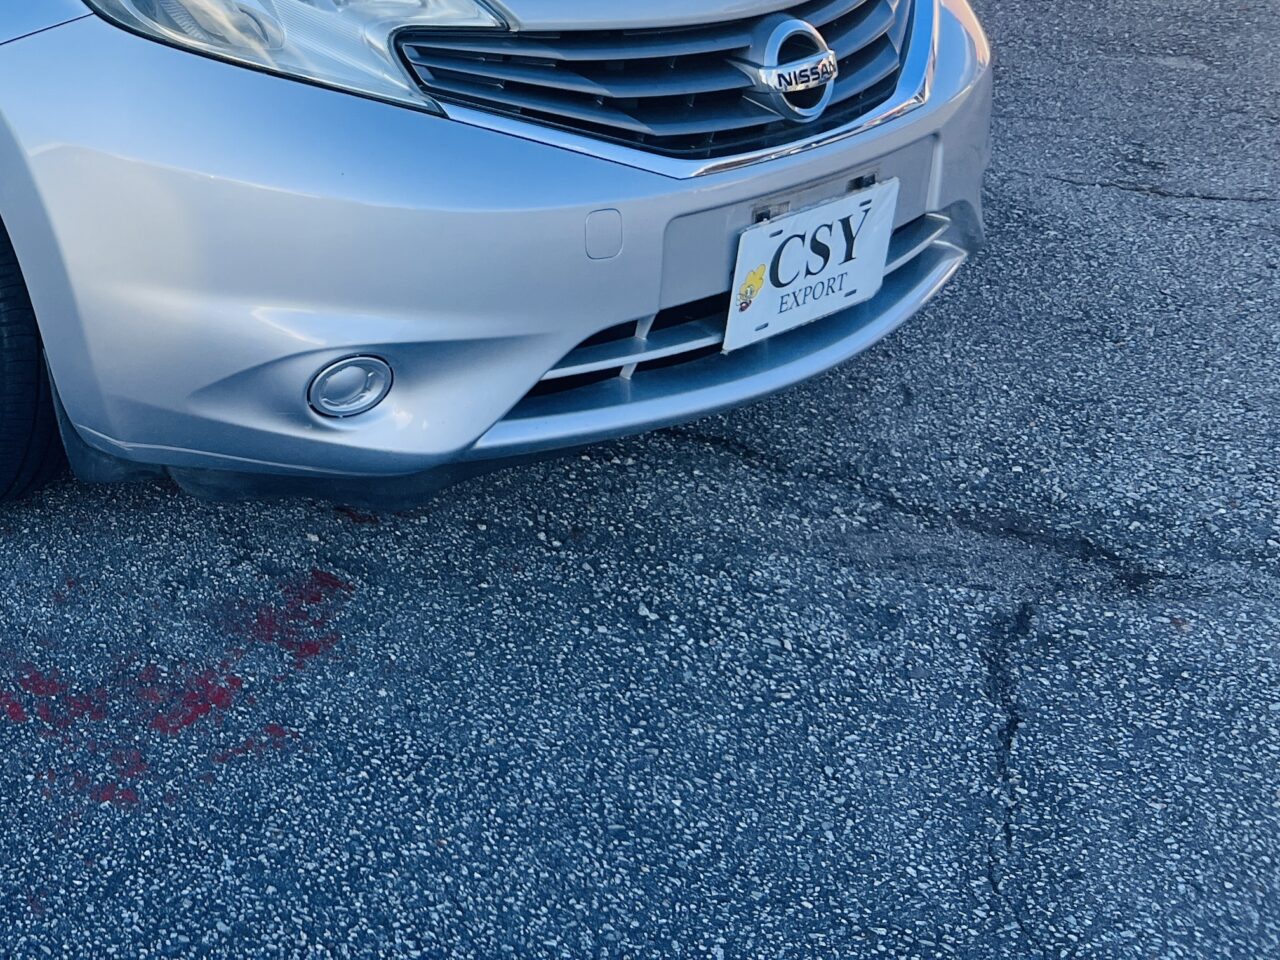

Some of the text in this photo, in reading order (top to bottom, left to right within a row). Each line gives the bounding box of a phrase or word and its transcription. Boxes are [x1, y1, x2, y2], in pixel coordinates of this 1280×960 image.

[777, 61, 837, 87] NISSAN
[769, 207, 872, 289] CSY
[777, 272, 848, 314] EXPORT
